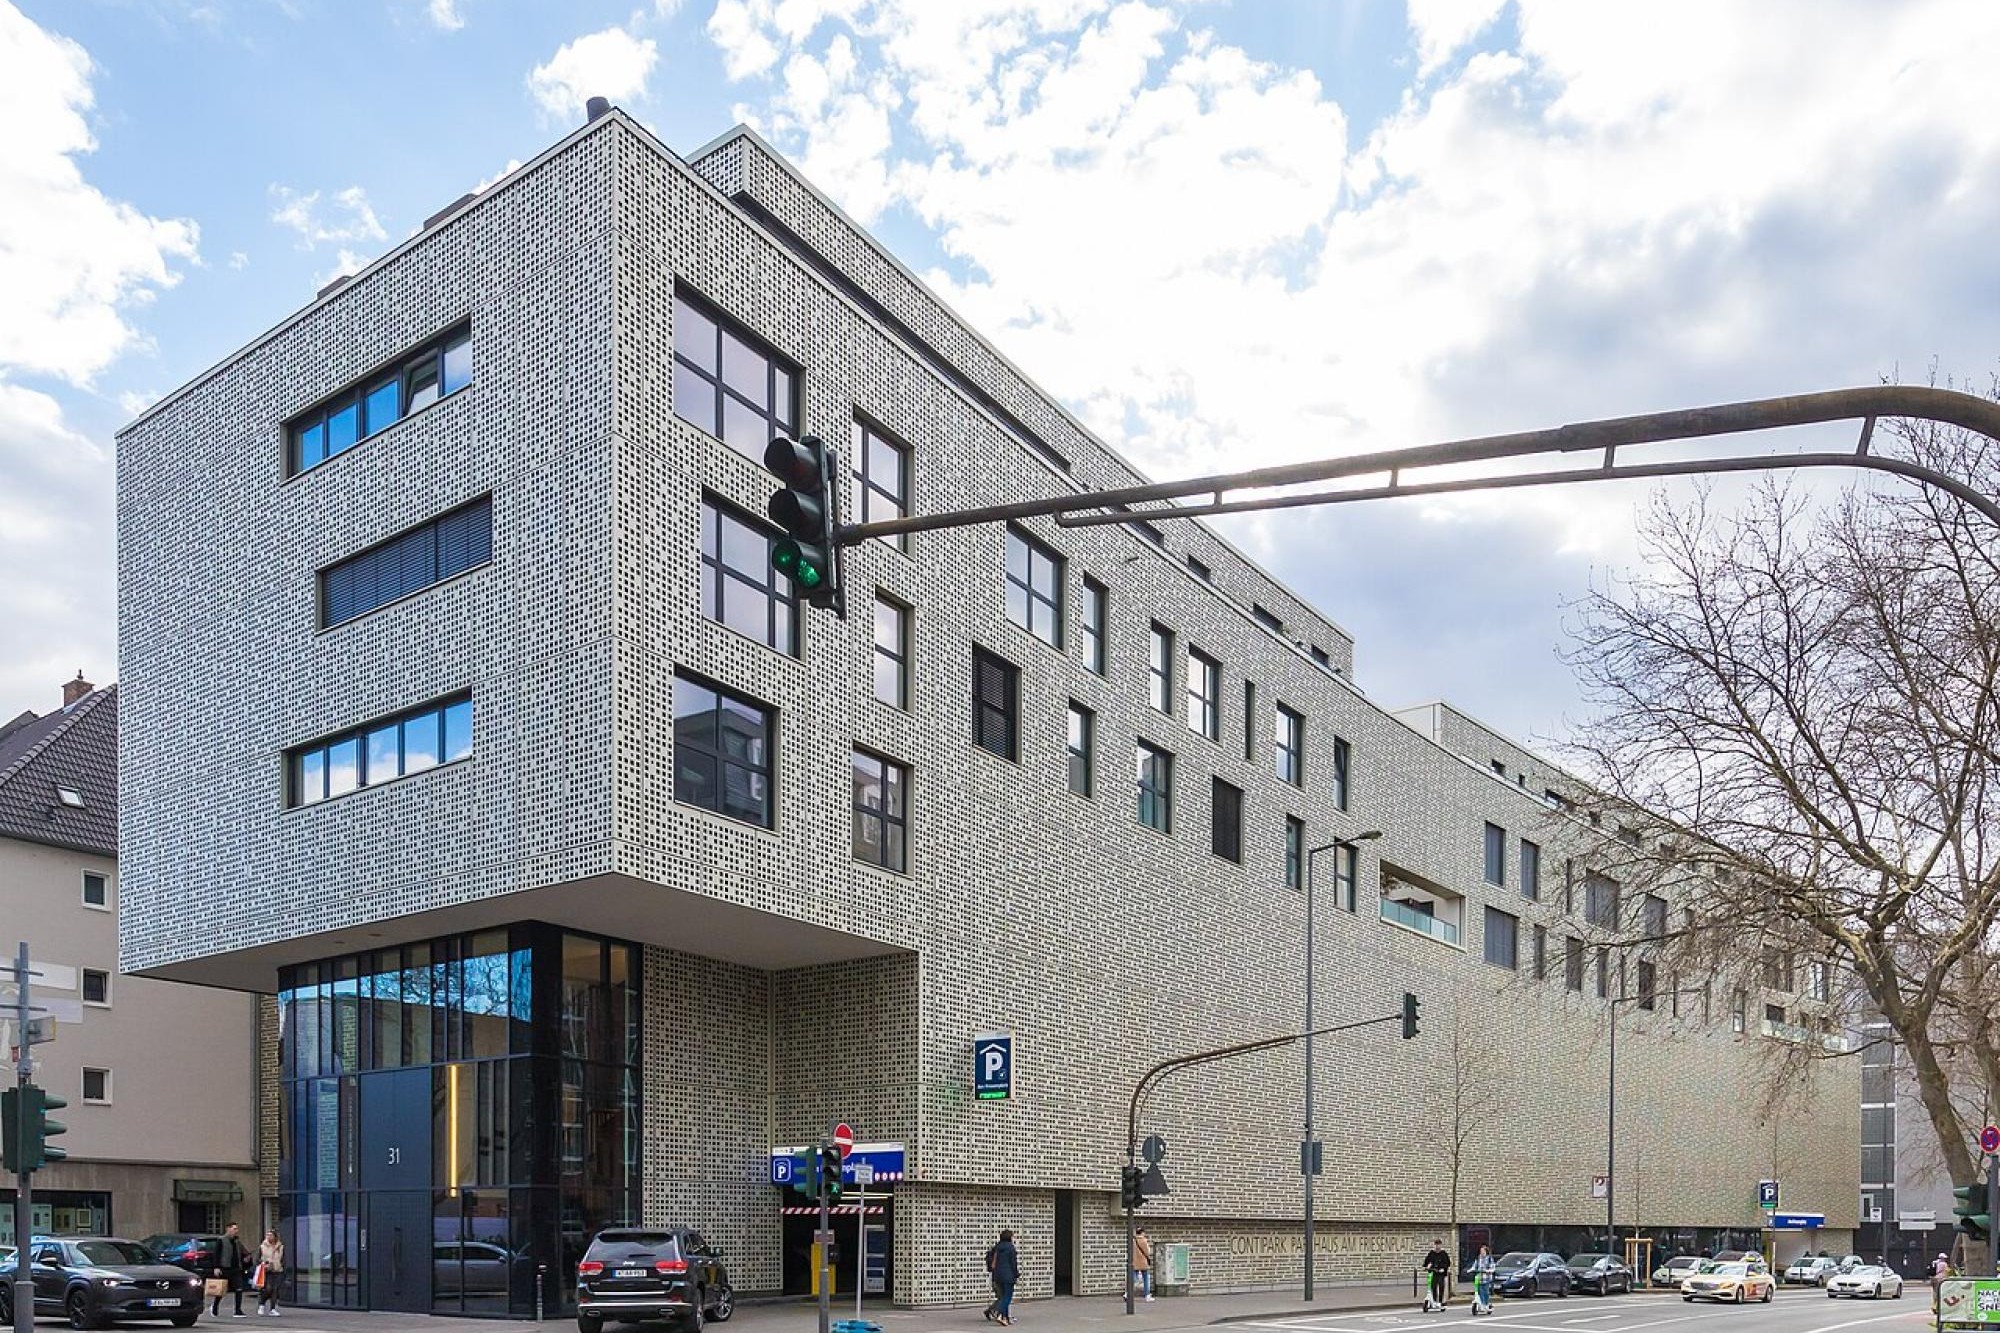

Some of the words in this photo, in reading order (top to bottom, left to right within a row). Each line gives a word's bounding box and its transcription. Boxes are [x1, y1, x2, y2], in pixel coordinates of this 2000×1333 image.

[986, 1052, 1003, 1080] P
[388, 1147, 400, 1164] 31
[777, 1164, 787, 1179] P
[1765, 1188, 1774, 1200] P
[1231, 1236, 1287, 1255] CONTIPARK
[1291, 1236, 1338, 1253] PAHAUS
[1341, 1237, 1356, 1252] AM
[1359, 1236, 1415, 1252] FRIESENPLATZ
